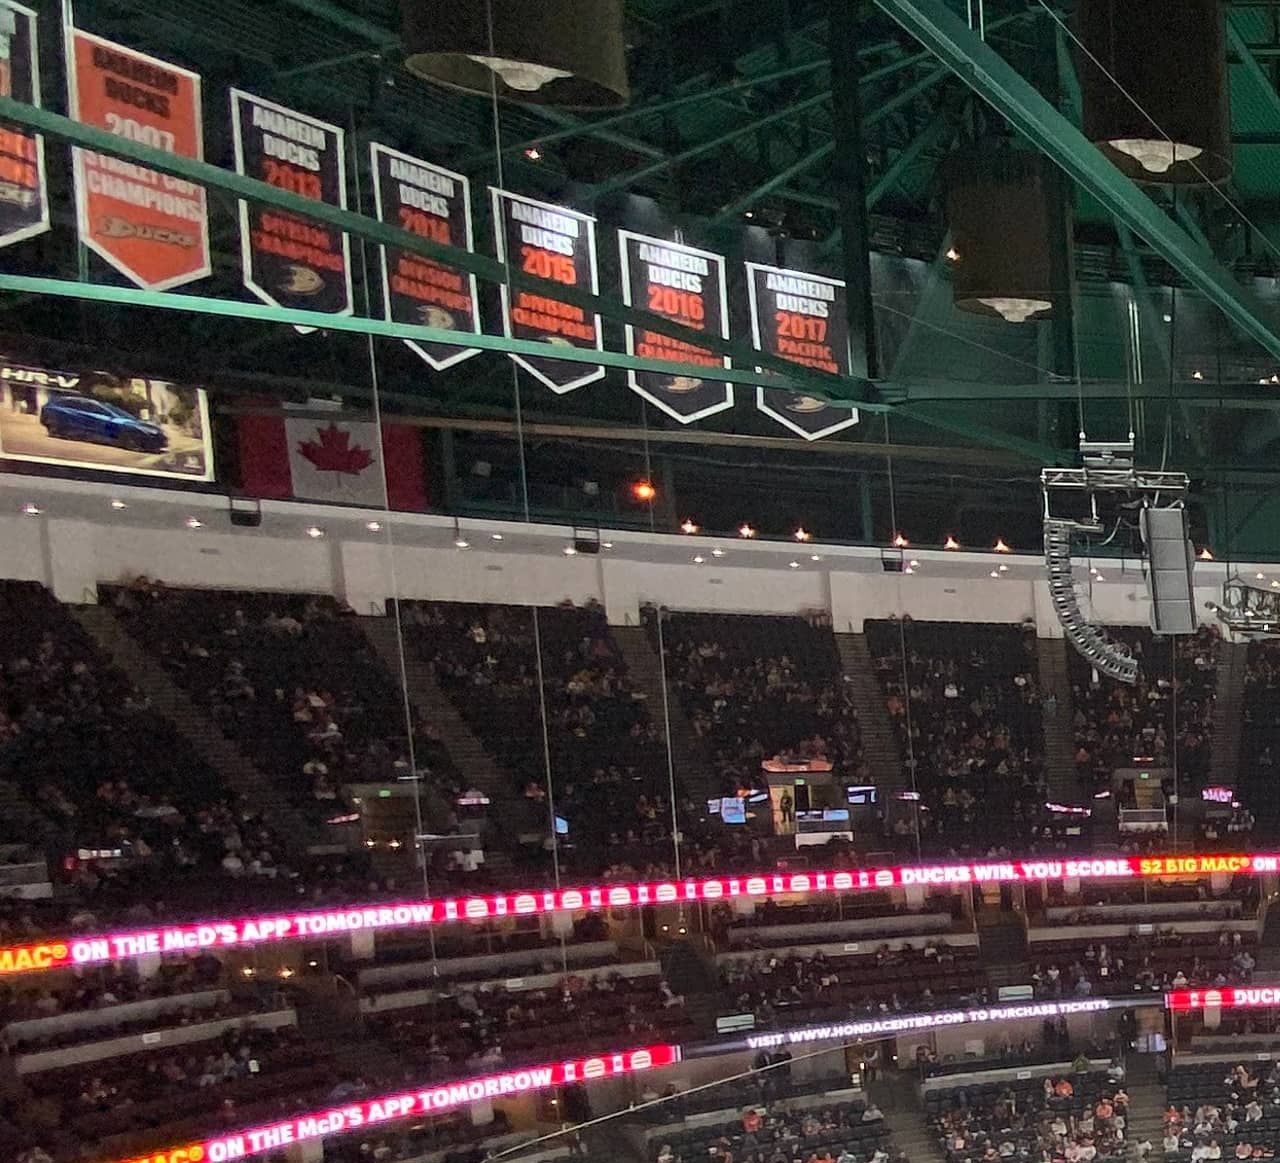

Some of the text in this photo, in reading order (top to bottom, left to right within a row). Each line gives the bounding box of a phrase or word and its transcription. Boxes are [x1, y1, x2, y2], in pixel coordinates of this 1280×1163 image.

[252, 105, 326, 150] ANAHEIM
[264, 133, 321, 171] DUCKS
[88, 170, 205, 222] CHAMPIONS
[390, 158, 454, 198] ANAHEIM
[400, 184, 449, 218] DUCKS
[511, 201, 579, 238] ANAHEIM
[521, 225, 574, 255] DUCKS
[522, 246, 576, 284] 2015
[640, 243, 709, 275] ANAHEIM
[648, 264, 702, 293] DUCKS
[767, 273, 835, 301] ANAHEIM
[648, 282, 704, 320] 2016
[776, 294, 829, 317] DUCKS
[775, 311, 827, 342] 2017
[2, 368, 80, 388] HR-V
[901, 868, 970, 885] DUCKS
[975, 865, 1019, 880] WIN.
[1023, 861, 1063, 877] YOU
[1067, 858, 1134, 876] SCORE.
[1166, 858, 1197, 872] BIG
[1254, 857, 1276, 870] ON
[72, 904, 434, 963] ON THE McD'S APP TOMORROW
[748, 1033, 784, 1049] VISIT
[970, 1010, 987, 1021] TO
[990, 1004, 1054, 1019] PURCHASE
[1059, 1000, 1109, 1013] TICKETS
[209, 1139, 244, 1161] ON
[250, 1125, 294, 1151] THE
[297, 1106, 363, 1139] McD'S
[367, 1096, 417, 1122] APP
[420, 1069, 552, 1110] TOMORROW
